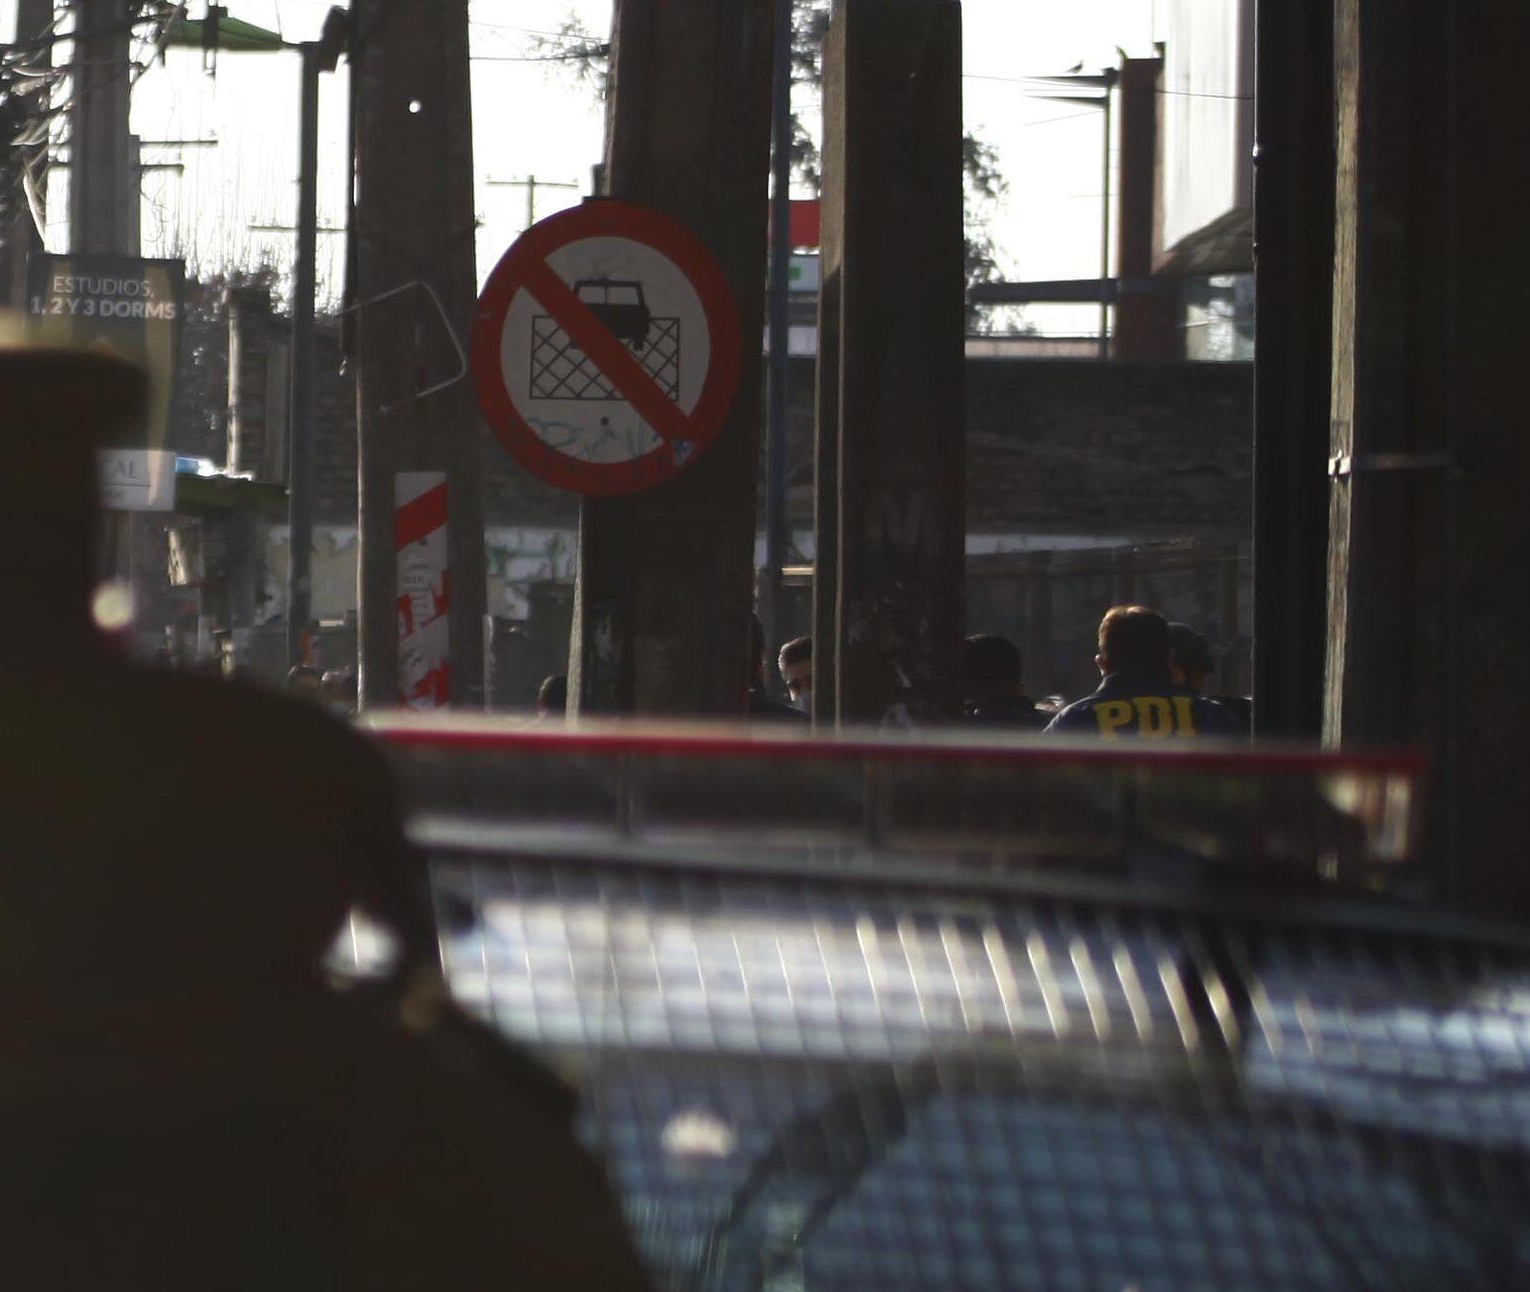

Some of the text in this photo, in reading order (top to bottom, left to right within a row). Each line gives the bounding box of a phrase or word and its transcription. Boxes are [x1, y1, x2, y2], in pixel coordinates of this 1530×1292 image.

[52, 275, 155, 298] ESTUDIOS,
[50, 298, 63, 315] 2
[64, 299, 79, 315] Y
[83, 300, 95, 317] 3
[99, 300, 176, 320] DORMS
[1093, 695, 1198, 741] PDI
